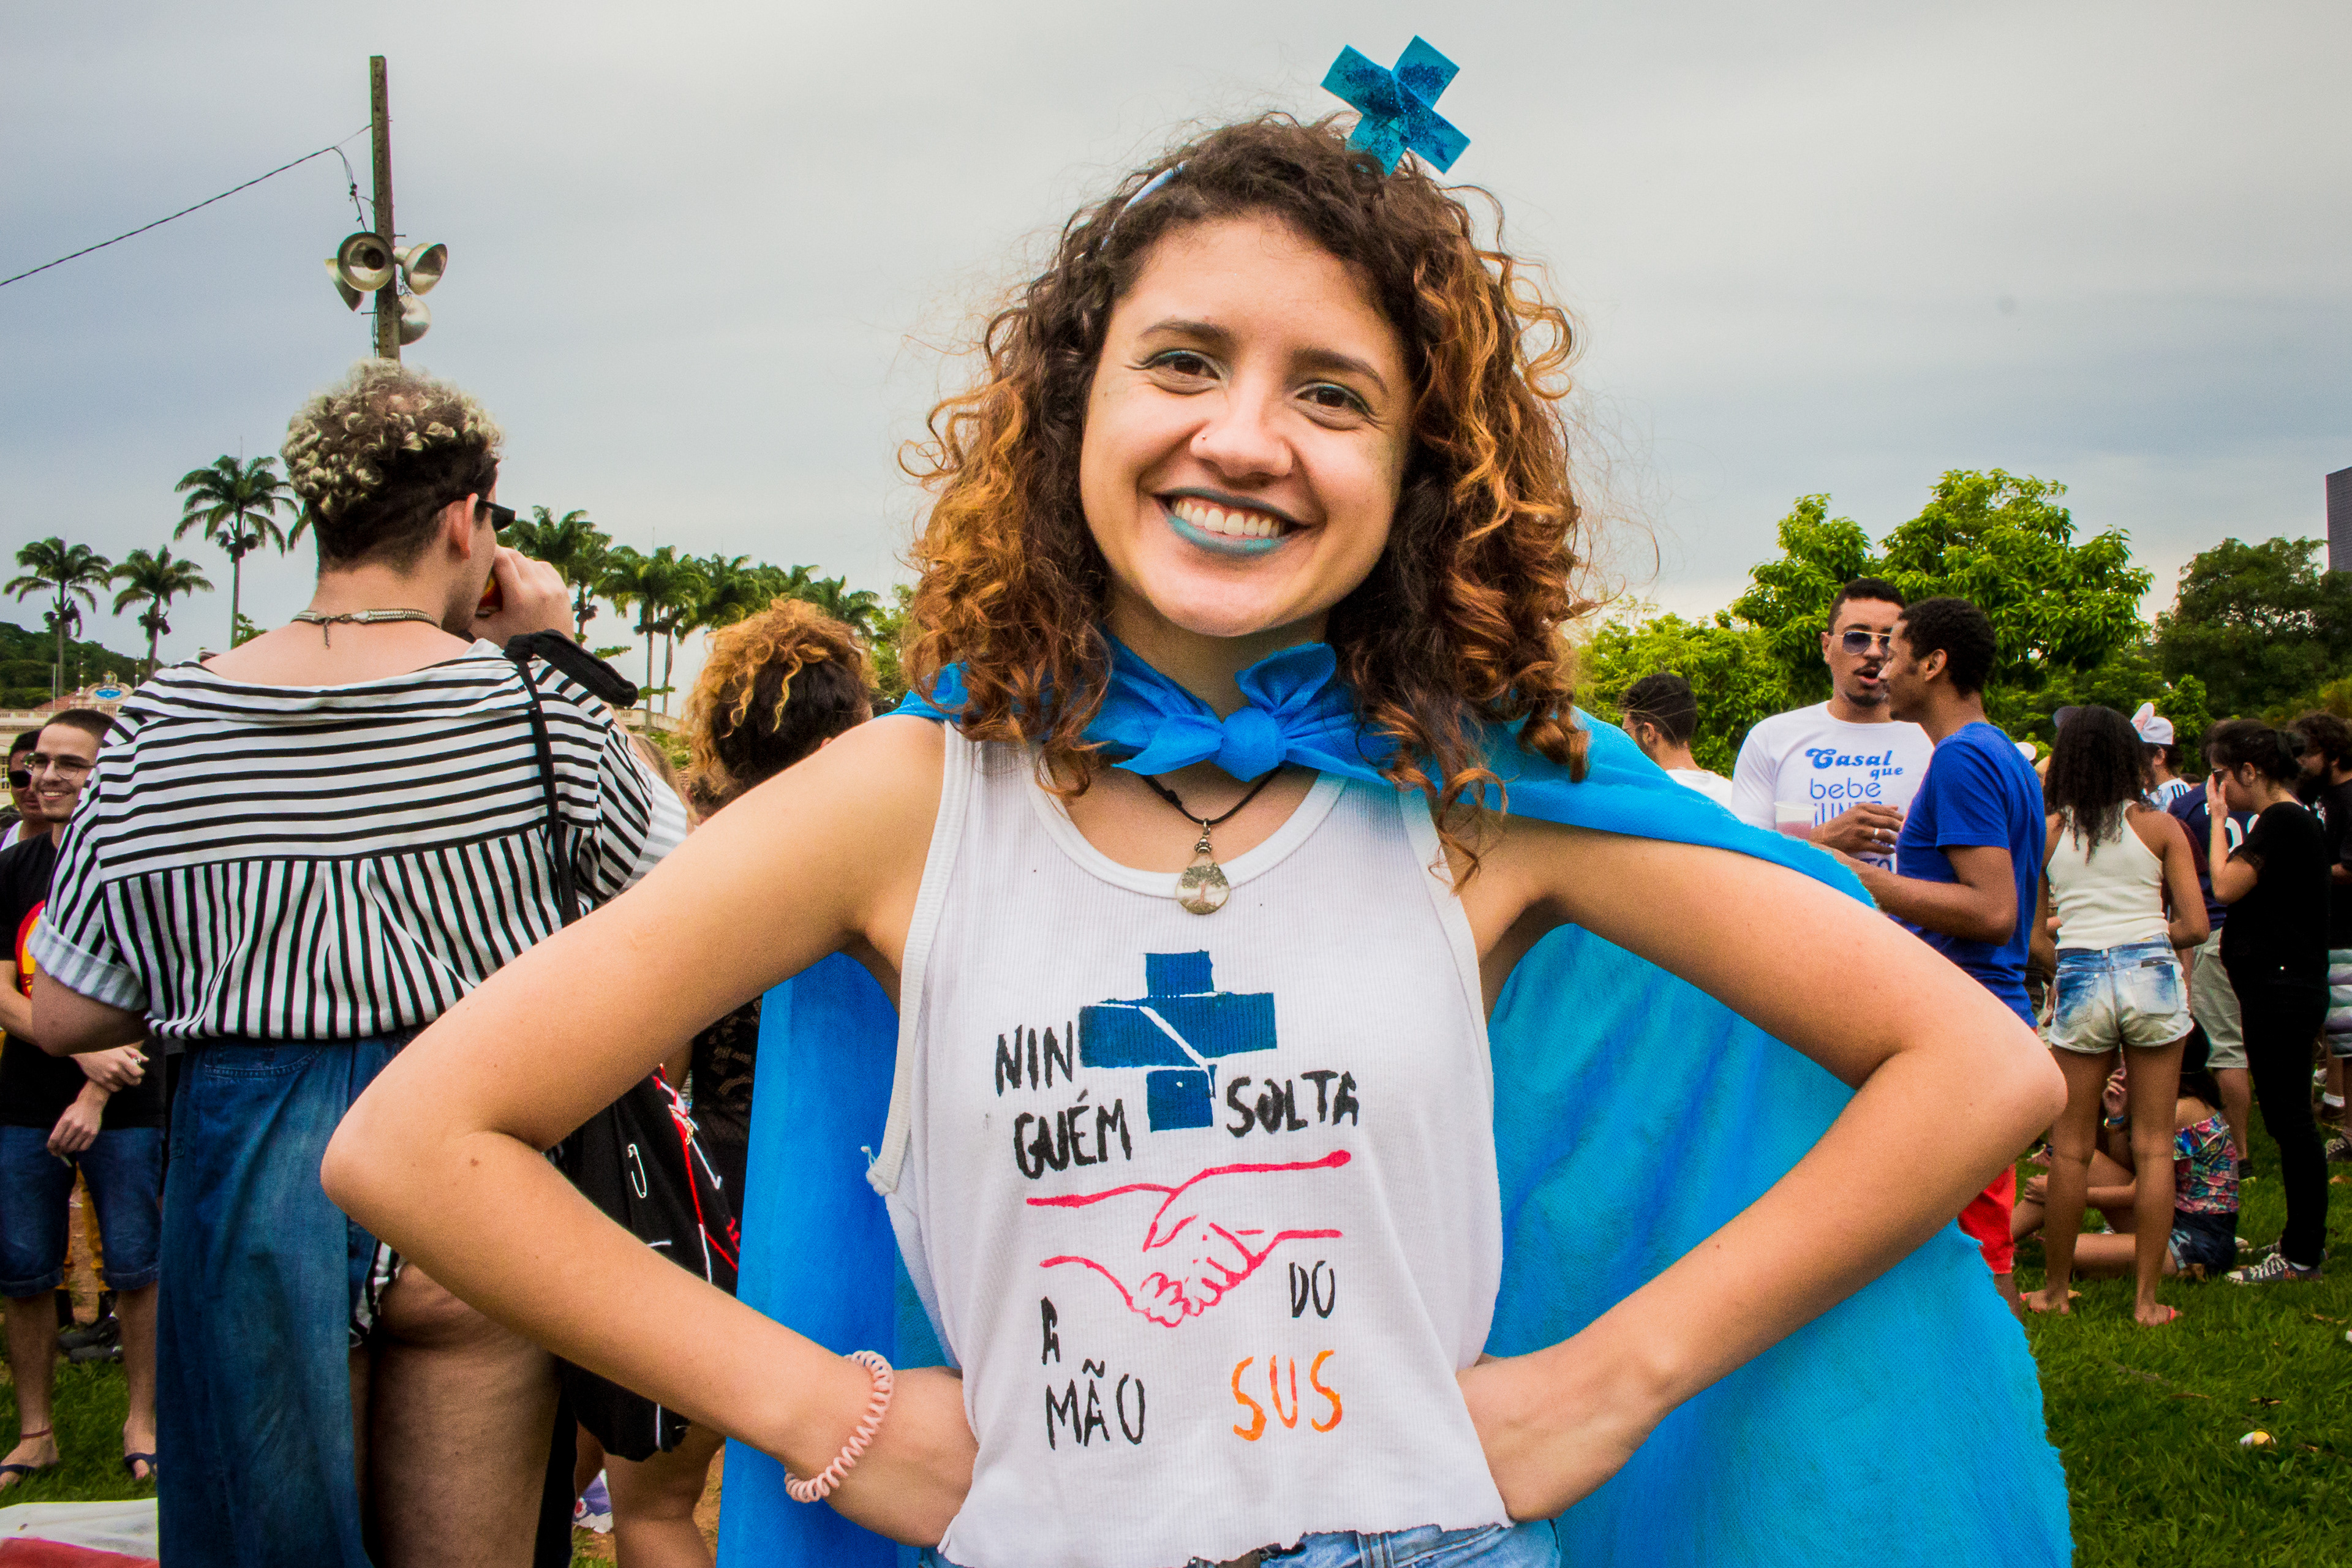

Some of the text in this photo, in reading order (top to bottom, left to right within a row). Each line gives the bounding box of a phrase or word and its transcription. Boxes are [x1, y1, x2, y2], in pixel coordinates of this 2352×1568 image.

[1806, 748, 1892, 769] Casal
[1870, 767, 1903, 780] que
[1810, 777, 1881, 799] bebe
[995, 1021, 1073, 1097] NIN
[1012, 1070, 1360, 1180] GUÉM SOLTA
[1289, 1261, 1335, 1319] DO
[1045, 1349, 1343, 1450] MÃO SUS
